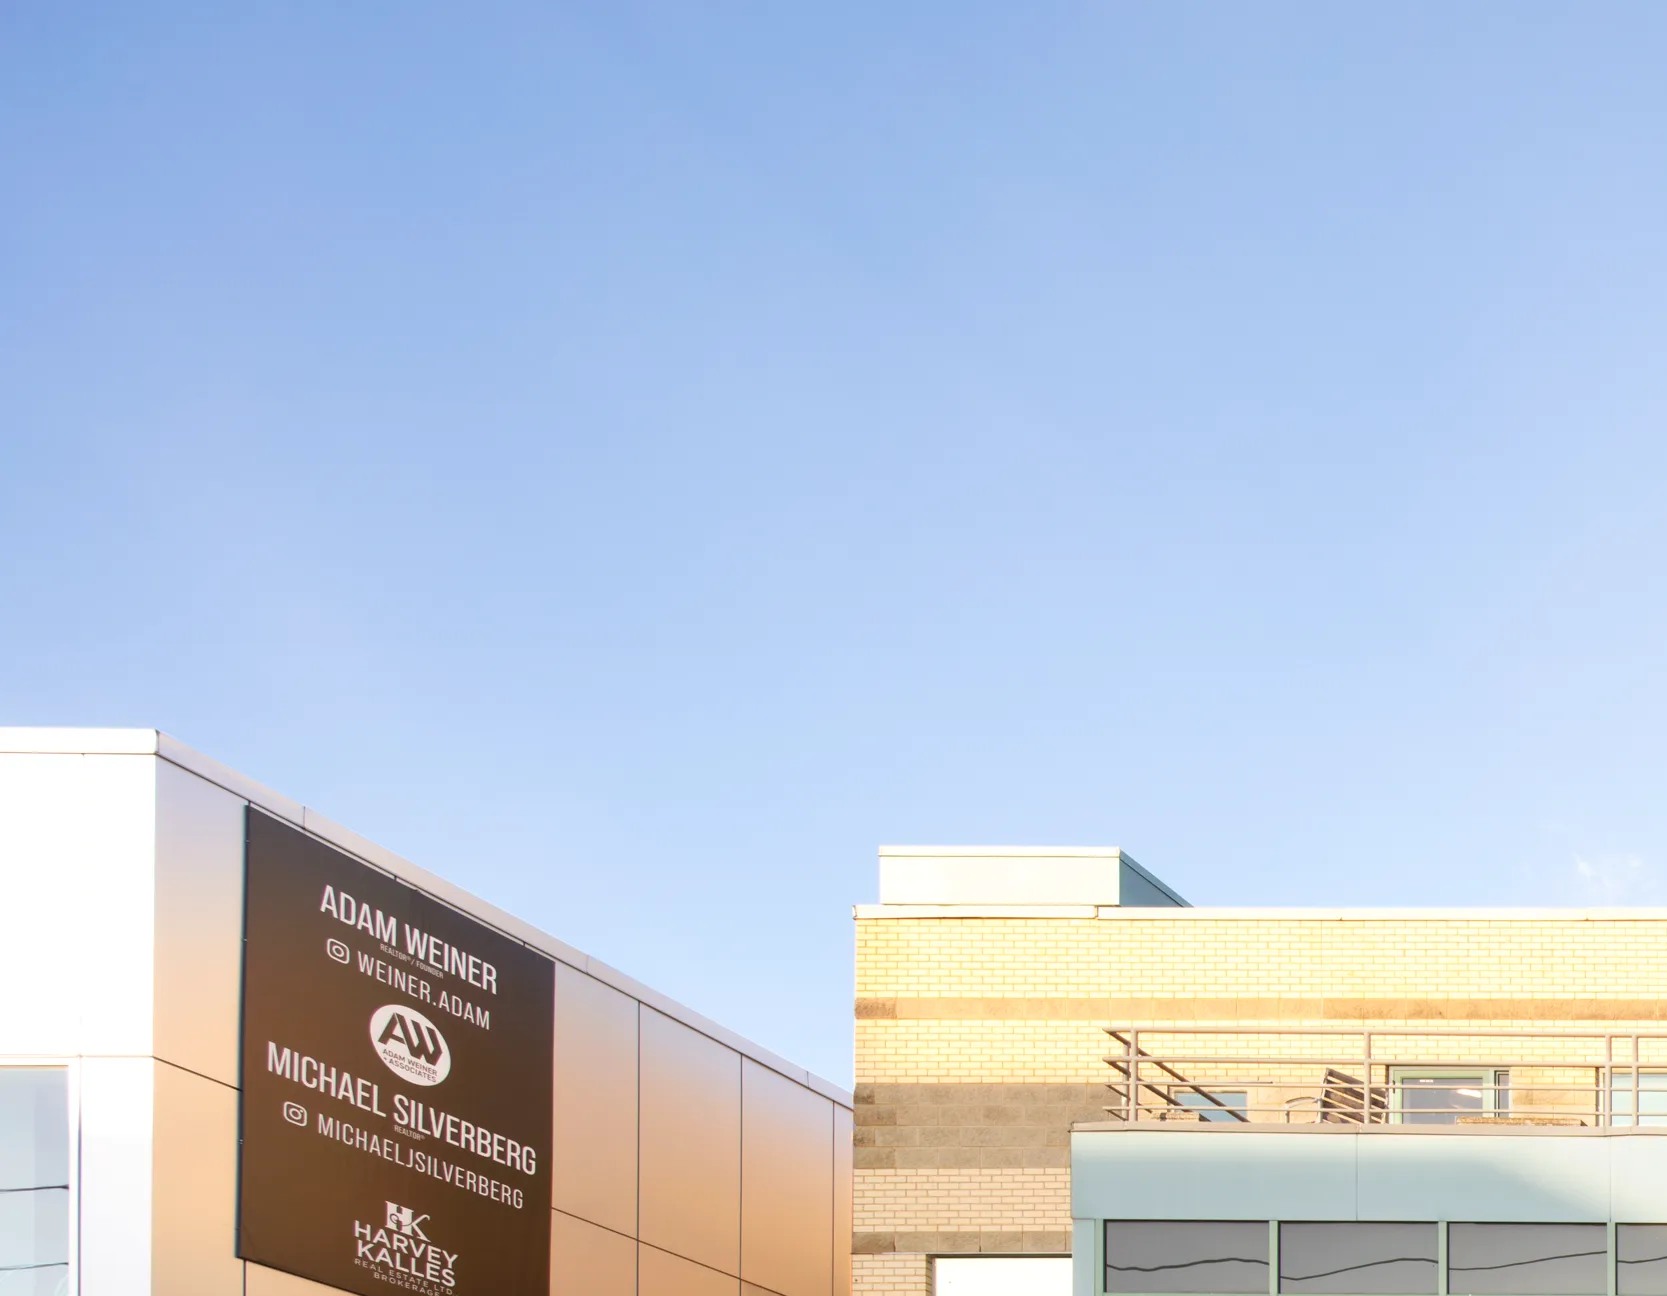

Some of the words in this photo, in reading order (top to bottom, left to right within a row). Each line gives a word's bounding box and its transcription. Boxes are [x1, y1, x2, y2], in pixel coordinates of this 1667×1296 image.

[320, 884, 397, 947] ADAM
[404, 923, 497, 995] WEINER
[357, 951, 490, 1030] WEINER.ADAM
[416, 961, 444, 979] FOUNDER
[378, 1013, 443, 1066] AW
[383, 1049, 405, 1063] ADAM
[408, 1058, 437, 1076] WEINER
[389, 1059, 436, 1082] ASSOCIATES
[268, 1041, 387, 1118] MICHAEL
[393, 1094, 536, 1176] SILVERBERG
[318, 1113, 523, 1209] MICHAELJSILVERBERG
[355, 1220, 459, 1269] HARVEY
[358, 1240, 456, 1287] KALLES
[354, 1258, 383, 1273] REAL
[389, 1270, 428, 1287] ESTATE
